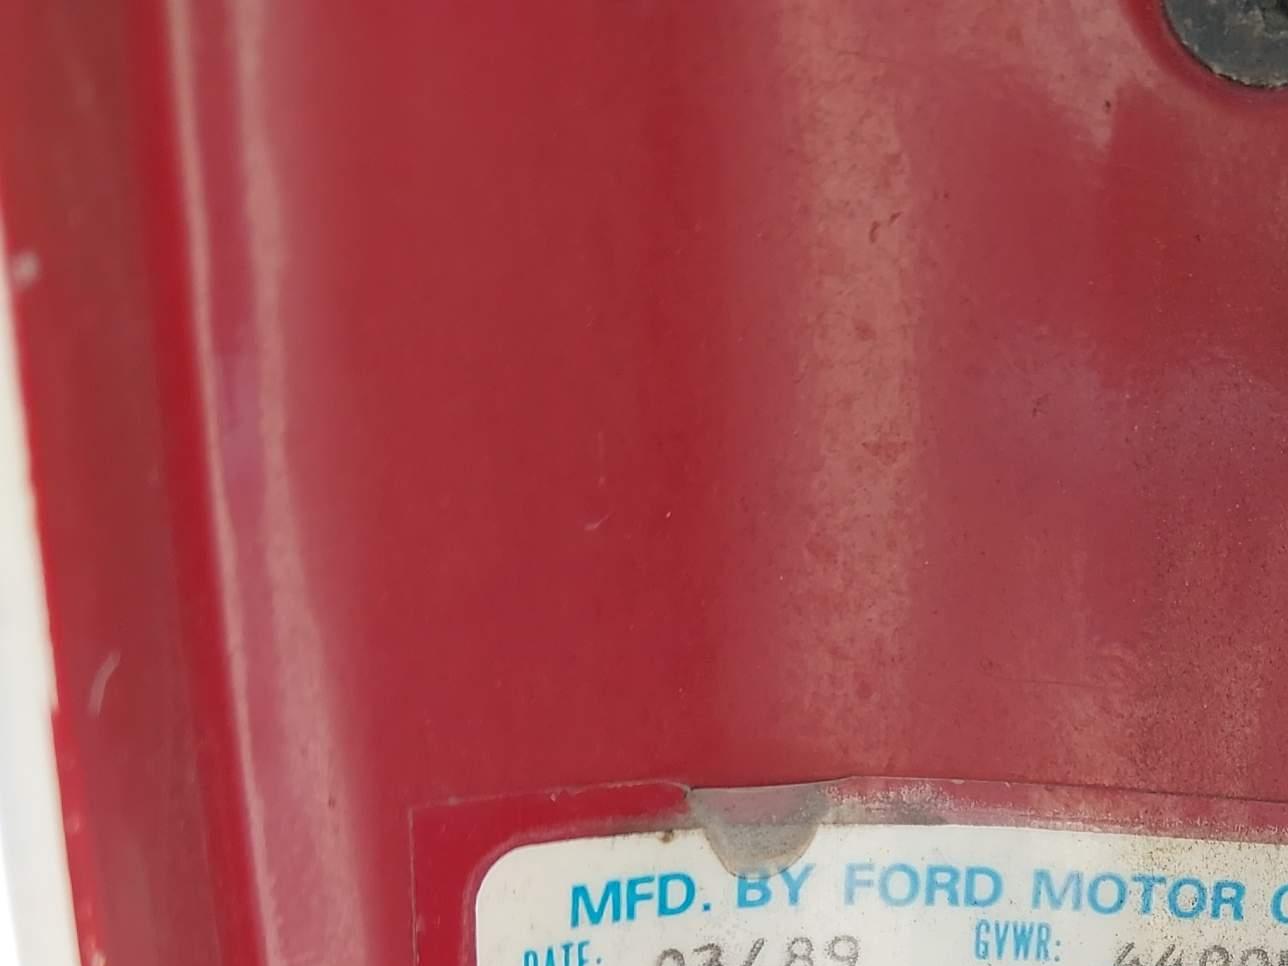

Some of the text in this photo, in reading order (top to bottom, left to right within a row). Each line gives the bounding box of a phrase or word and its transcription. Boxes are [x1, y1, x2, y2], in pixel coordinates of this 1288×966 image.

[570, 872, 711, 928] MFD.
[737, 861, 816, 909] BY
[843, 863, 1004, 910] FORD
[1033, 870, 1246, 924] MOTOR
[974, 918, 1061, 963] GVWR:
